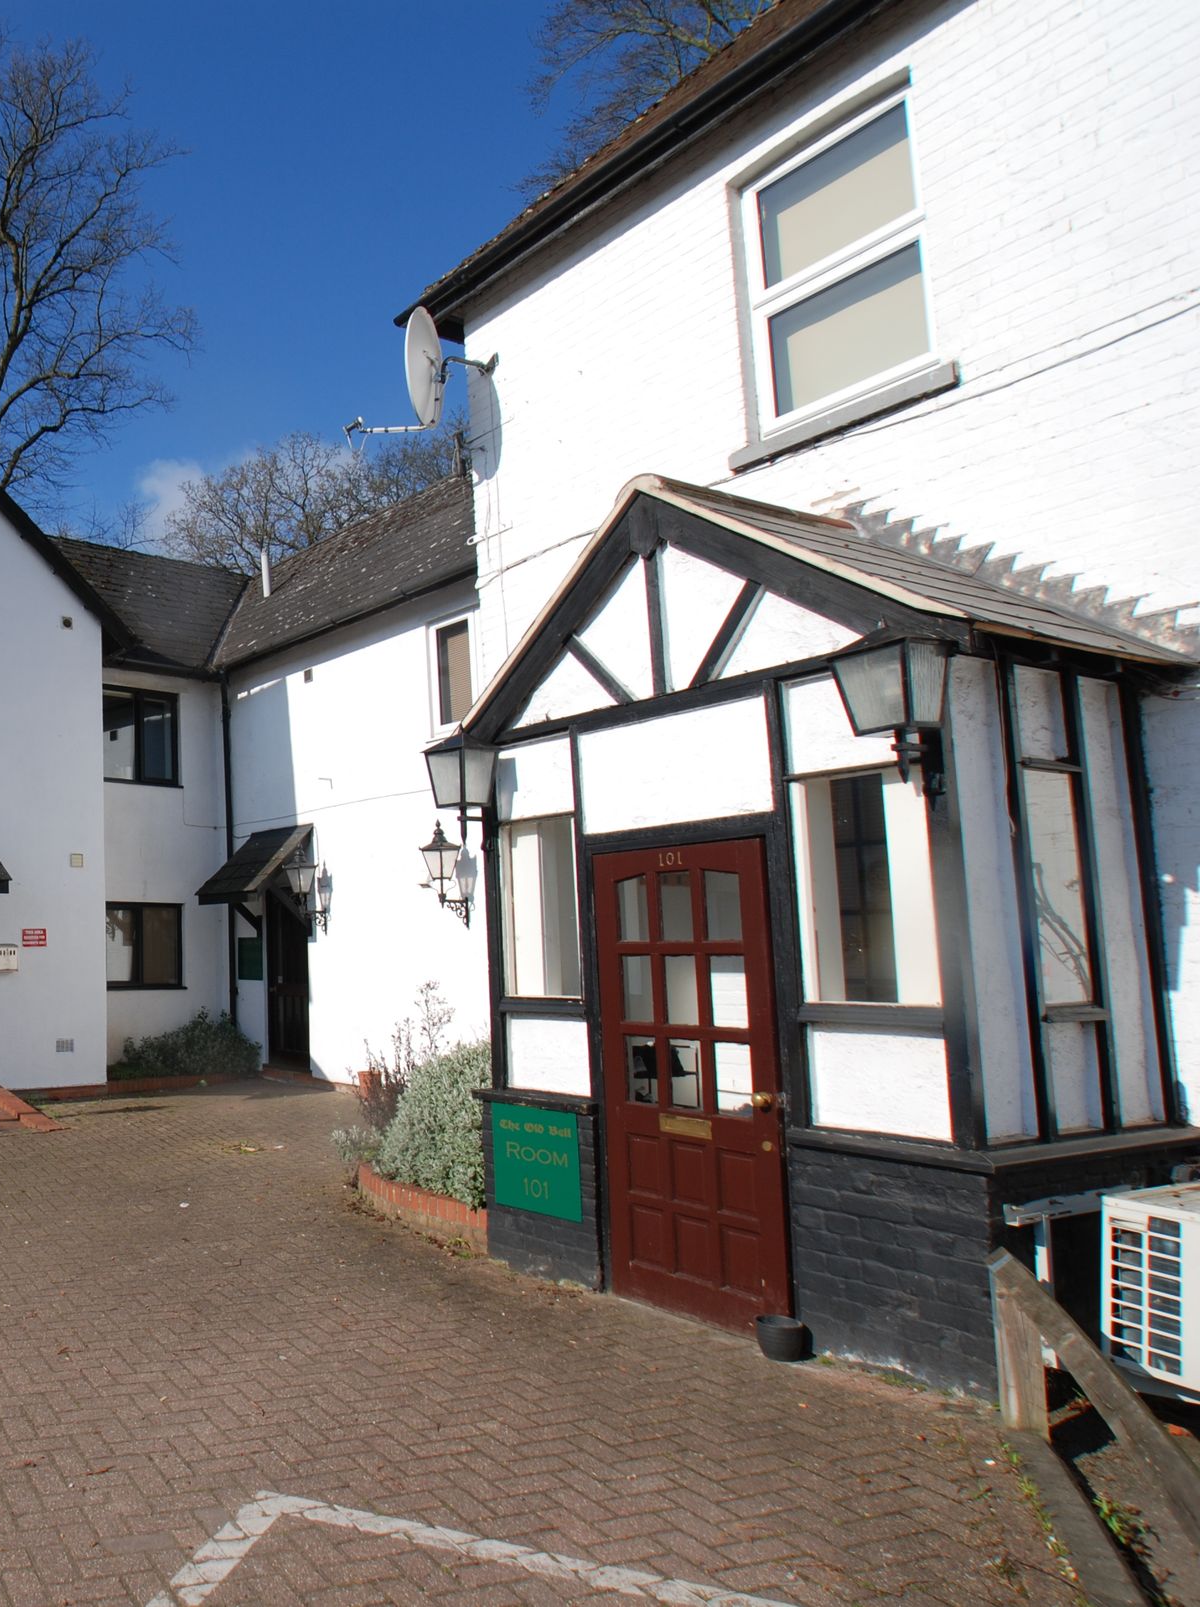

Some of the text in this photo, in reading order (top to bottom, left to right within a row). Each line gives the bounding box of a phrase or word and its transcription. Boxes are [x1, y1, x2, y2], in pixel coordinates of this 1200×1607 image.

[658, 851, 682, 867] 101
[499, 1119, 520, 1132] The
[523, 1122, 544, 1134] Old
[506, 1141, 569, 1168] ROOM
[523, 1177, 549, 1200] 101
